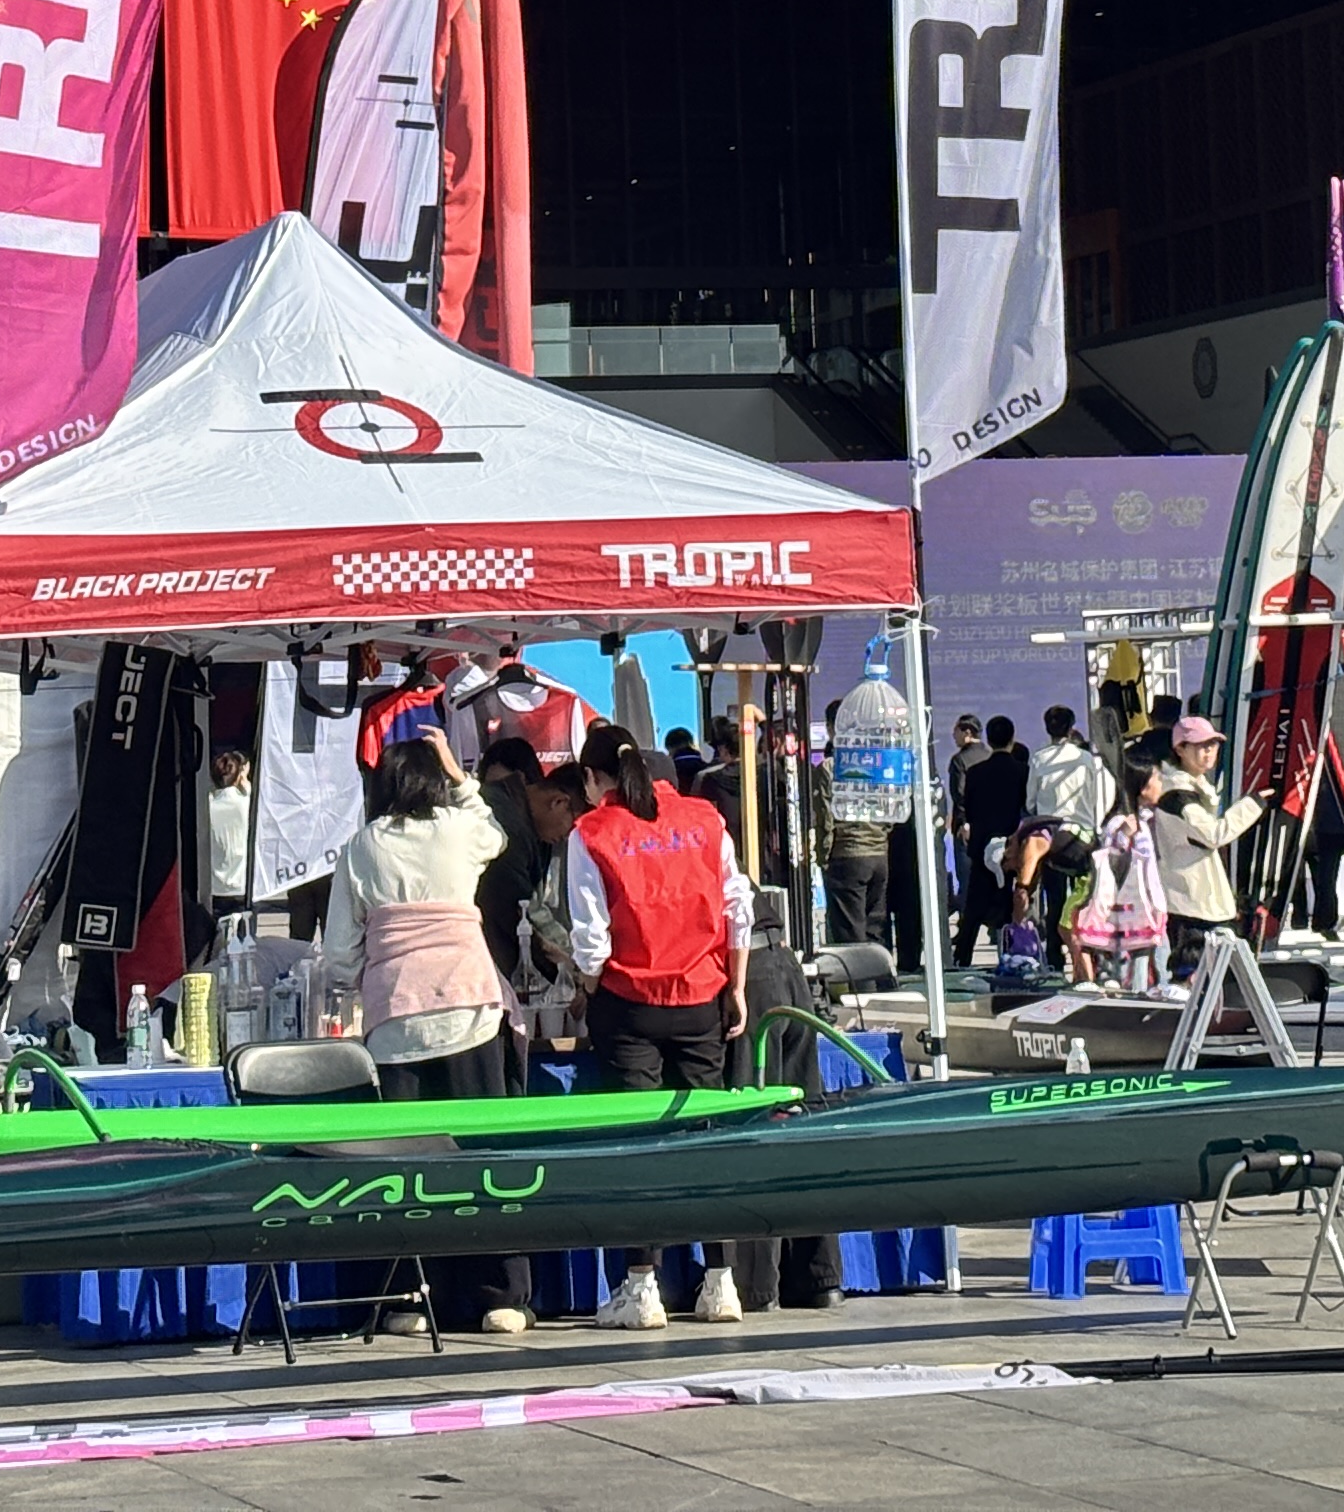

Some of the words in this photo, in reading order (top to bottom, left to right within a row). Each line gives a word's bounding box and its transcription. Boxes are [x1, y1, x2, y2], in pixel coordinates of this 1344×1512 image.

[952, 386, 1043, 452] DESIGN
[600, 540, 813, 589] TROPIC
[31, 573, 136, 603] BLACK
[134, 566, 277, 597] PROJECT
[276, 861, 307, 884] FLO
[1012, 1029, 1067, 1060] TROPIC
[990, 1073, 1174, 1107] SUPERSONIC
[251, 1164, 546, 1213] NALU
[261, 1202, 524, 1228] canoes
